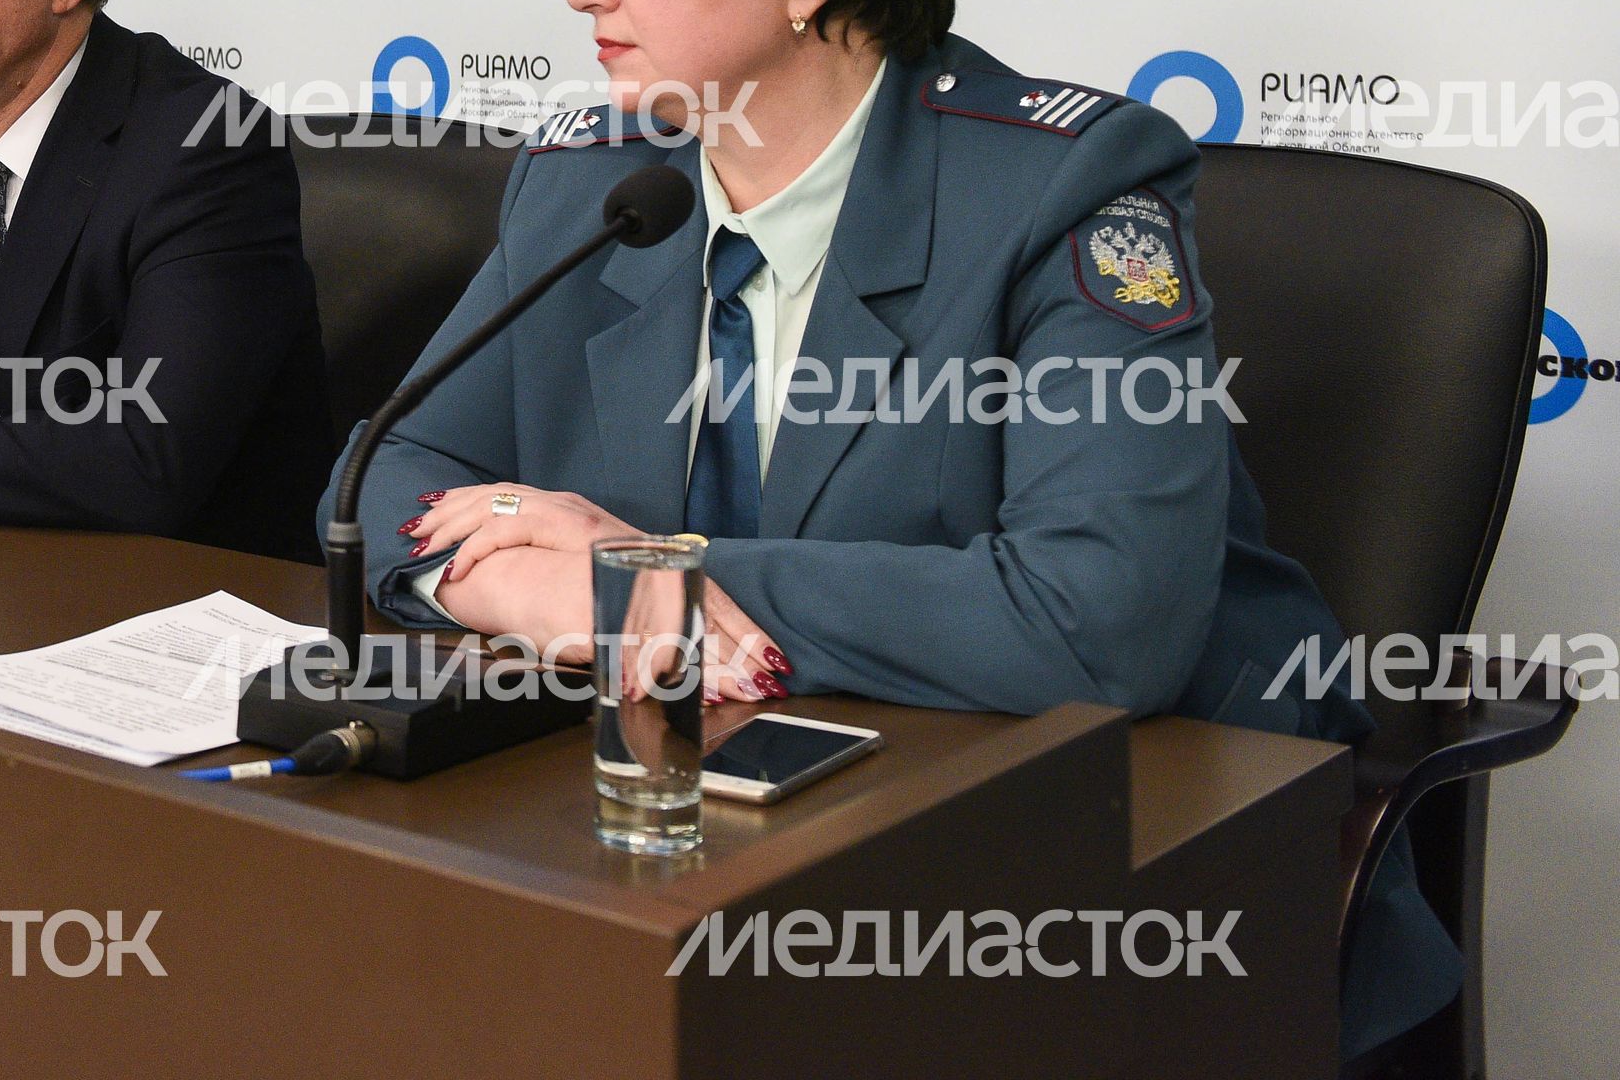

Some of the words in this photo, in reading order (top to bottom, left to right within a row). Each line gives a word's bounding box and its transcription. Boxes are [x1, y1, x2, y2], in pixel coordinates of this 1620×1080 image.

[460, 53, 551, 80] РИАМО
[1261, 72, 1400, 105] РИАМО
[1260, 111, 1339, 124] Региональное
[1260, 126, 1364, 141] Информационное
[1367, 129, 1424, 141] Агентство
